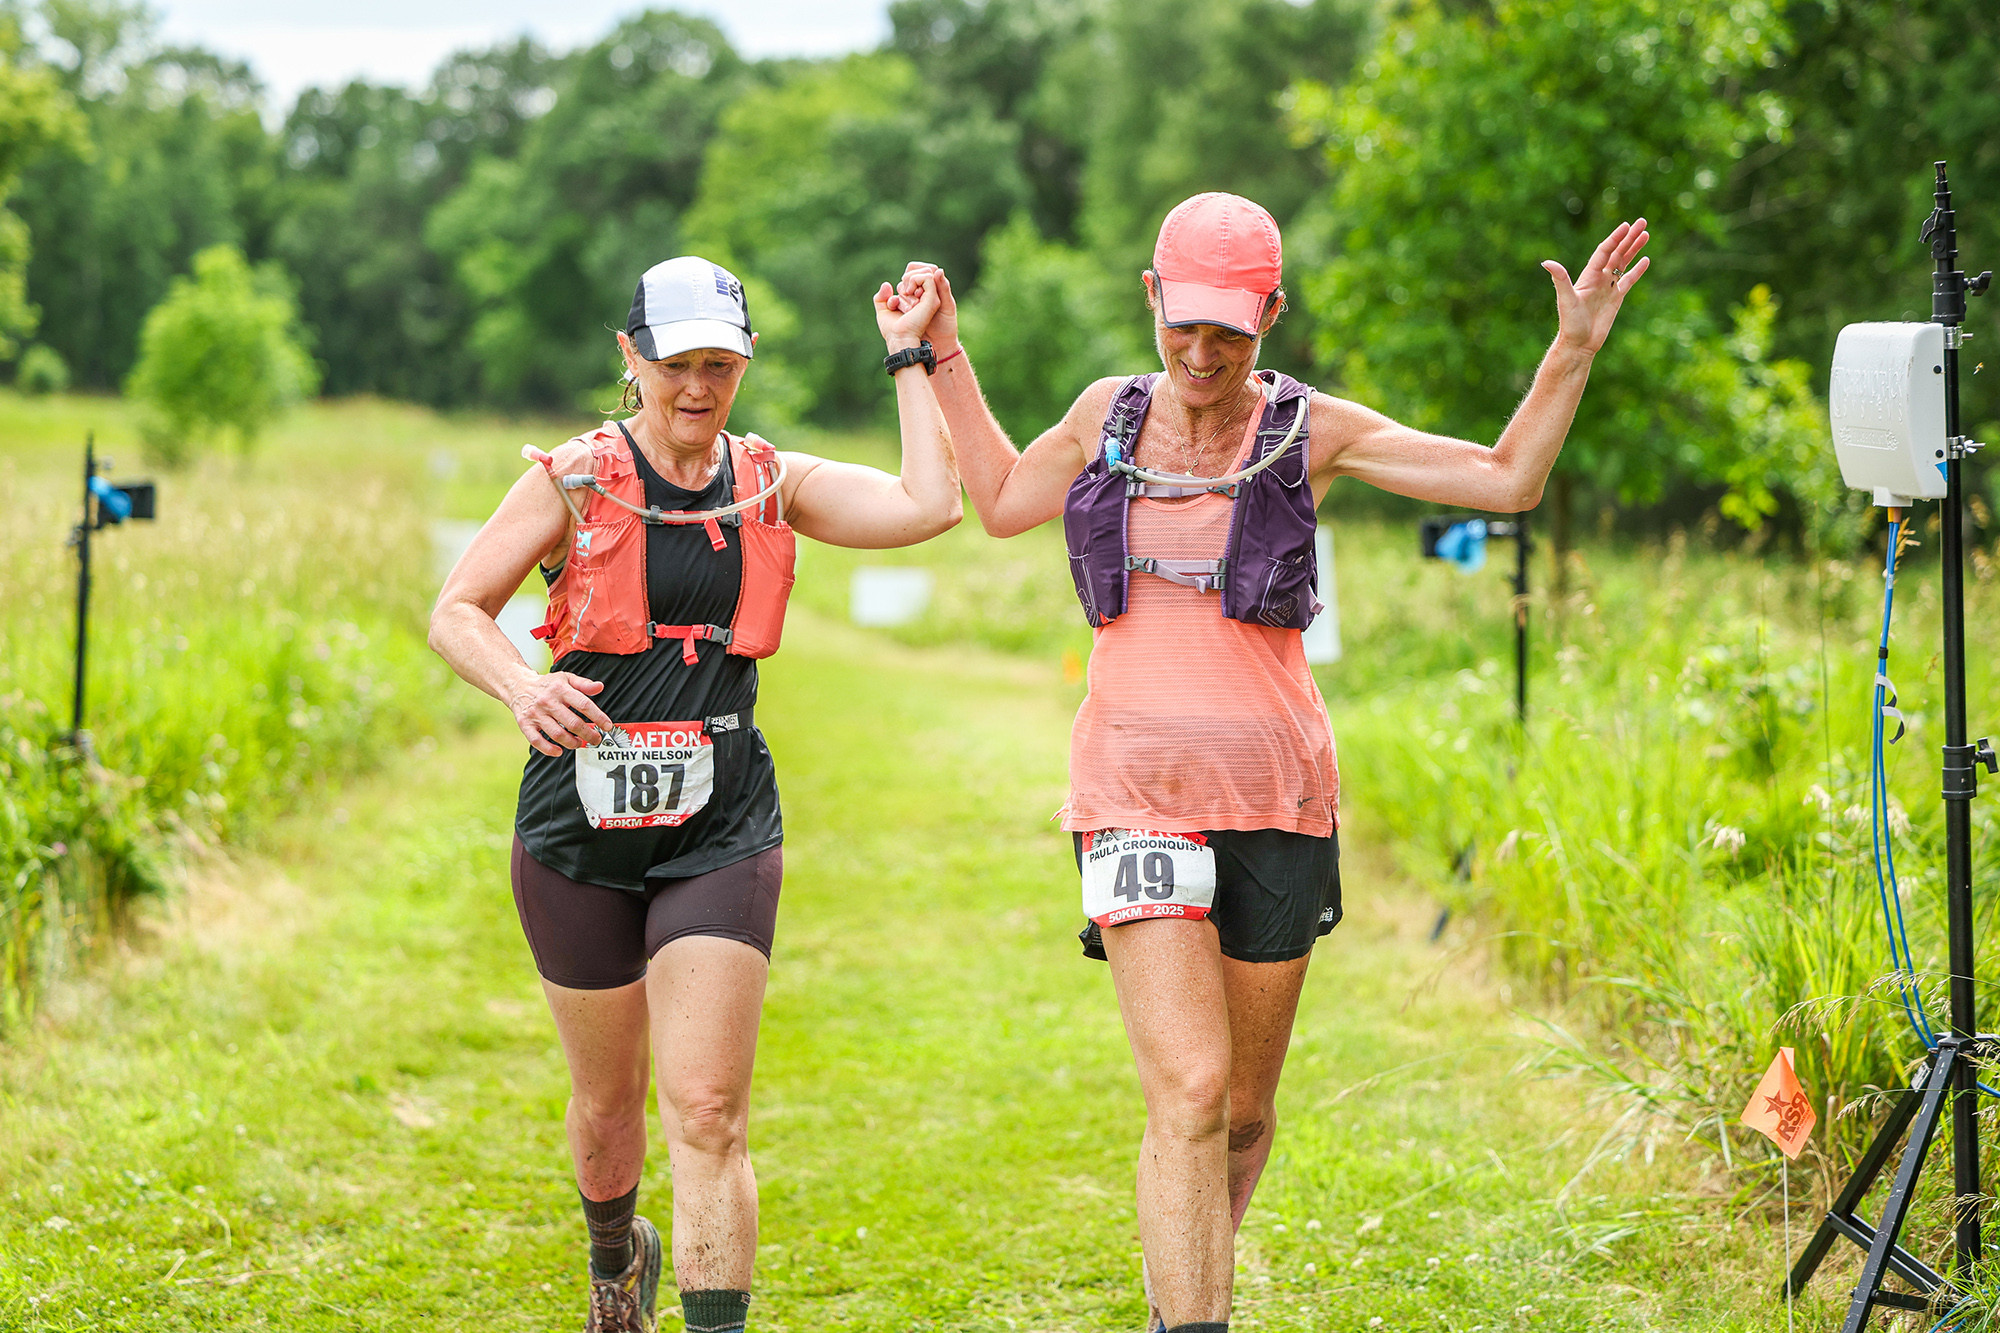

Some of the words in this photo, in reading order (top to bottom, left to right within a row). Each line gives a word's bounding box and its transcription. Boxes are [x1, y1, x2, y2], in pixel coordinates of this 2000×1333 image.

[632, 730, 702, 748] AFTON
[597, 751, 638, 761] KATHY
[642, 750, 693, 760] NELSON
[606, 763, 685, 814] 187
[605, 818, 643, 828] 50KM
[652, 815, 682, 825] 2025
[1089, 844, 1119, 863] PAULA
[1122, 839, 1204, 852] CROONQUIST
[1113, 851, 1175, 903] 49
[1108, 906, 1143, 923] 50KM
[1153, 905, 1184, 916] 2025
